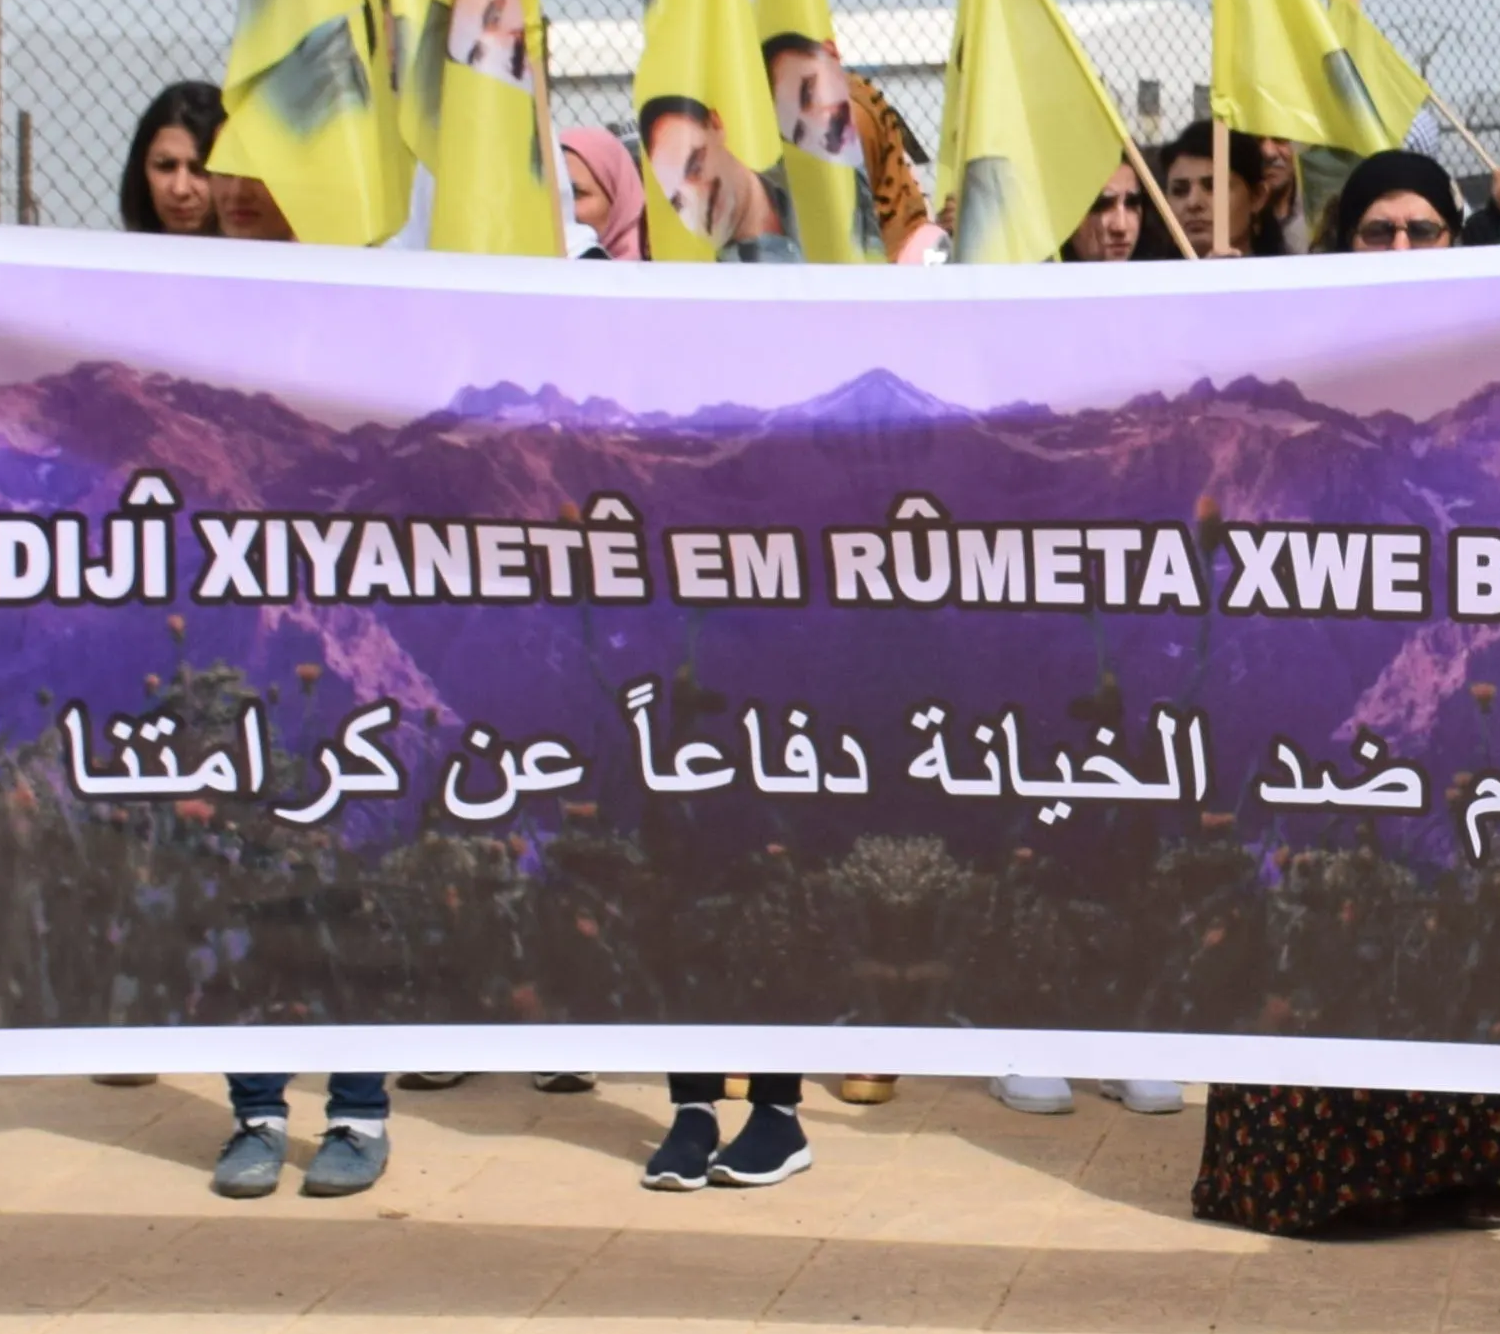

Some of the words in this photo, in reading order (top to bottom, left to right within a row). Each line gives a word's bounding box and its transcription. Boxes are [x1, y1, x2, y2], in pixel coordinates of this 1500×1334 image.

[197, 496, 646, 601] XIYANETÊ
[669, 531, 802, 601] EM
[829, 496, 1203, 608] RÛMETA
[1226, 528, 1424, 614] XWE
[63, 704, 401, 825] كرامتنا
[442, 728, 585, 822] عن
[906, 704, 1208, 827] الخيانة
[1258, 739, 1424, 810] ضد
